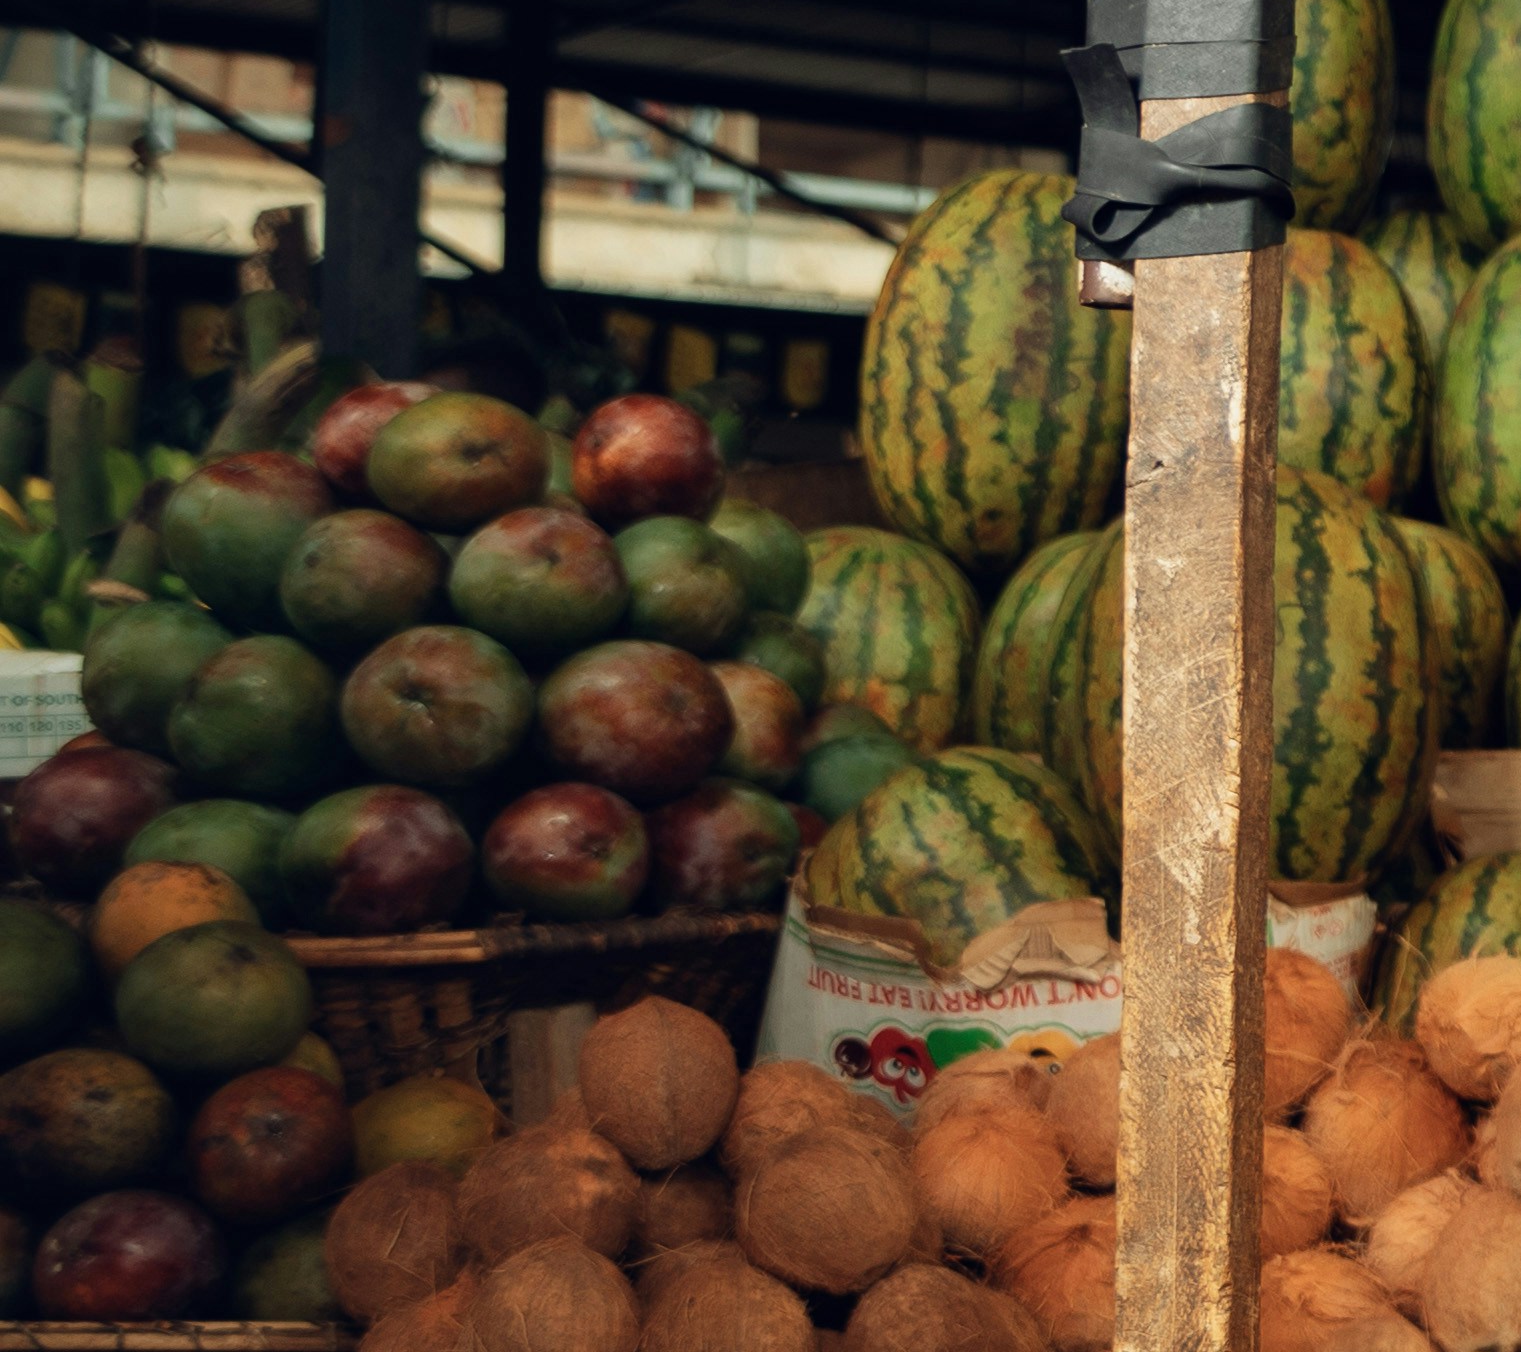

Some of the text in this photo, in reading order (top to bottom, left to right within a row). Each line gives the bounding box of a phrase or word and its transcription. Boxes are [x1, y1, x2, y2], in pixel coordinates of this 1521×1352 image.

[808, 964, 862, 1000] FRUIT
[868, 985, 914, 1009] EAT
[1048, 975, 1122, 1005] ON'T
